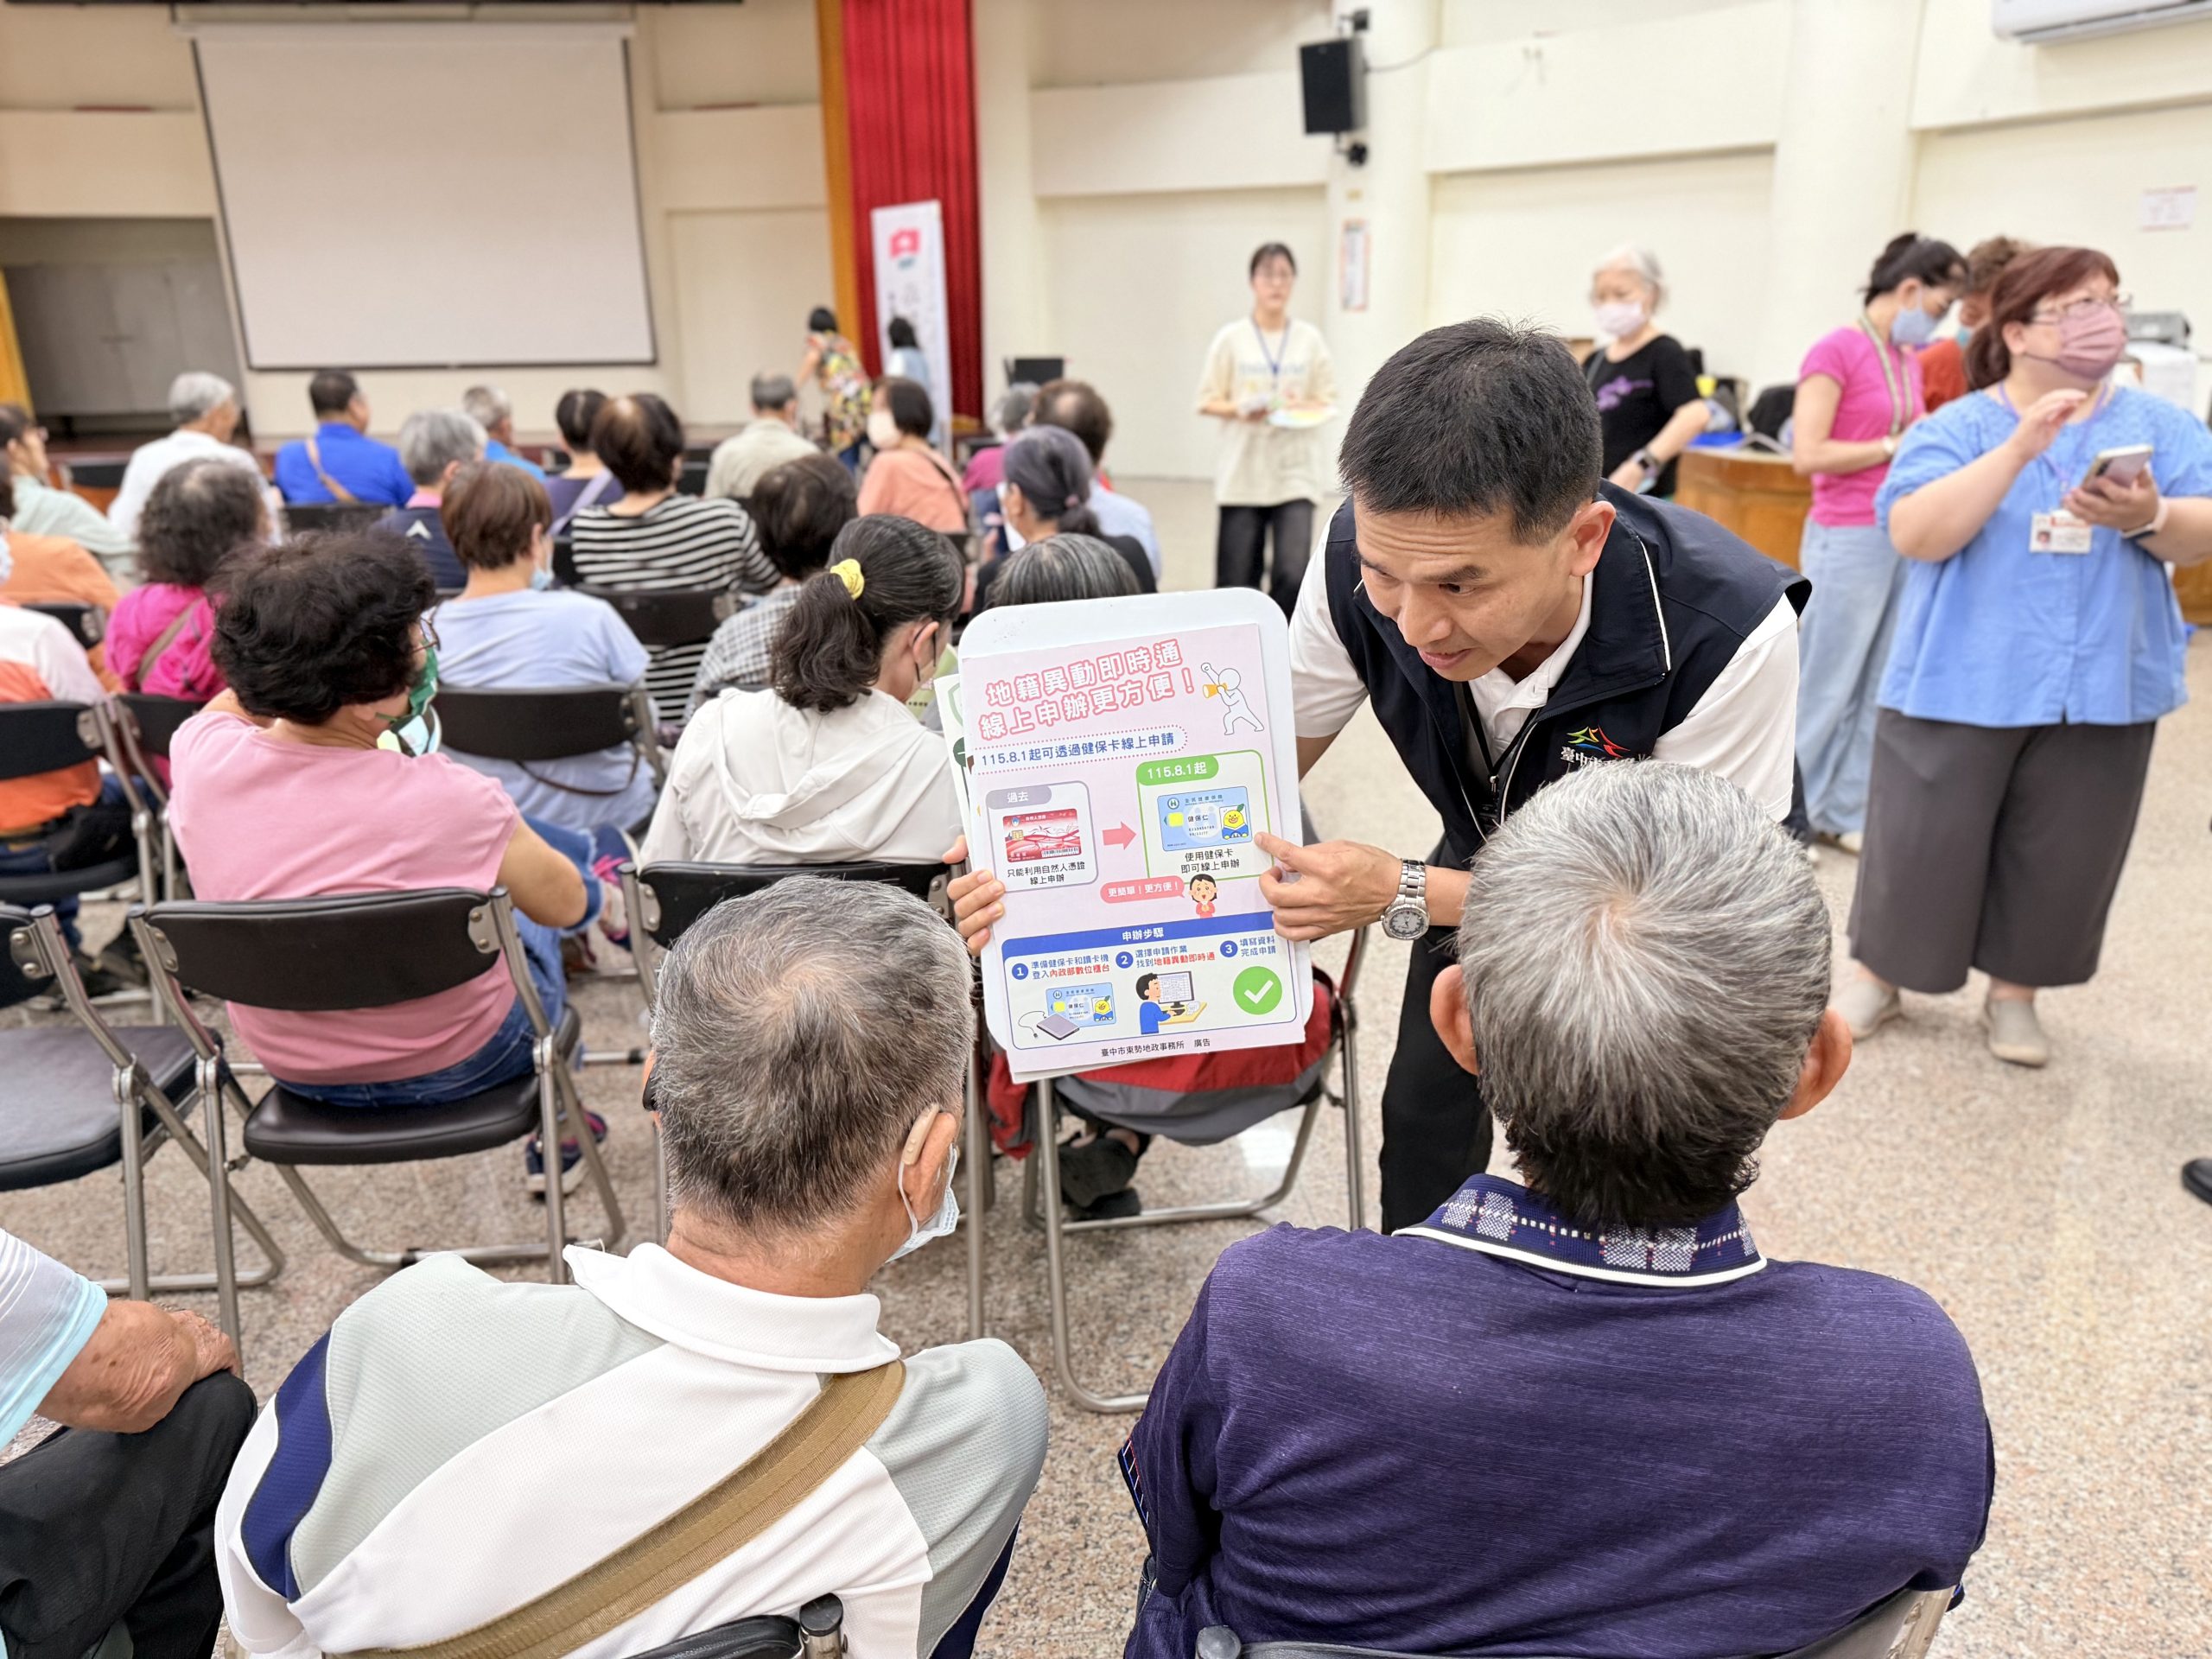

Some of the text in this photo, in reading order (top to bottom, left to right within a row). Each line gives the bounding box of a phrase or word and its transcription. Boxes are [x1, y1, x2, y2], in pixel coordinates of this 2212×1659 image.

[985, 639, 1184, 709] 地籍異動即時通
[978, 667, 1196, 742] 線上申辦更方便！
[982, 731, 1175, 766] 115.8.1起可透過健保卡線上申請
[1147, 761, 1207, 779] 115.8.1起
[1007, 791, 1029, 804] 過去
[1185, 848, 1233, 862] 使用健保卡
[1007, 861, 1086, 879] 只能利用自然人憑證
[1180, 858, 1240, 874] 即可線上申辦
[1029, 873, 1065, 886] 線上申辦
[1122, 926, 1165, 942] 申辦步驟
[1239, 935, 1275, 946] 填寫資料
[1135, 944, 1188, 958] 選擇申請作業
[1241, 945, 1277, 957] 完成申請
[1031, 953, 1109, 969] 準備健保卡和讀卡機
[1135, 951, 1217, 969] 找到地籍異動即時通
[1032, 963, 1110, 980] 登入內政部數位櫃台
[1101, 1039, 1211, 1057] 臺中市東勢地政事務所 廣告
